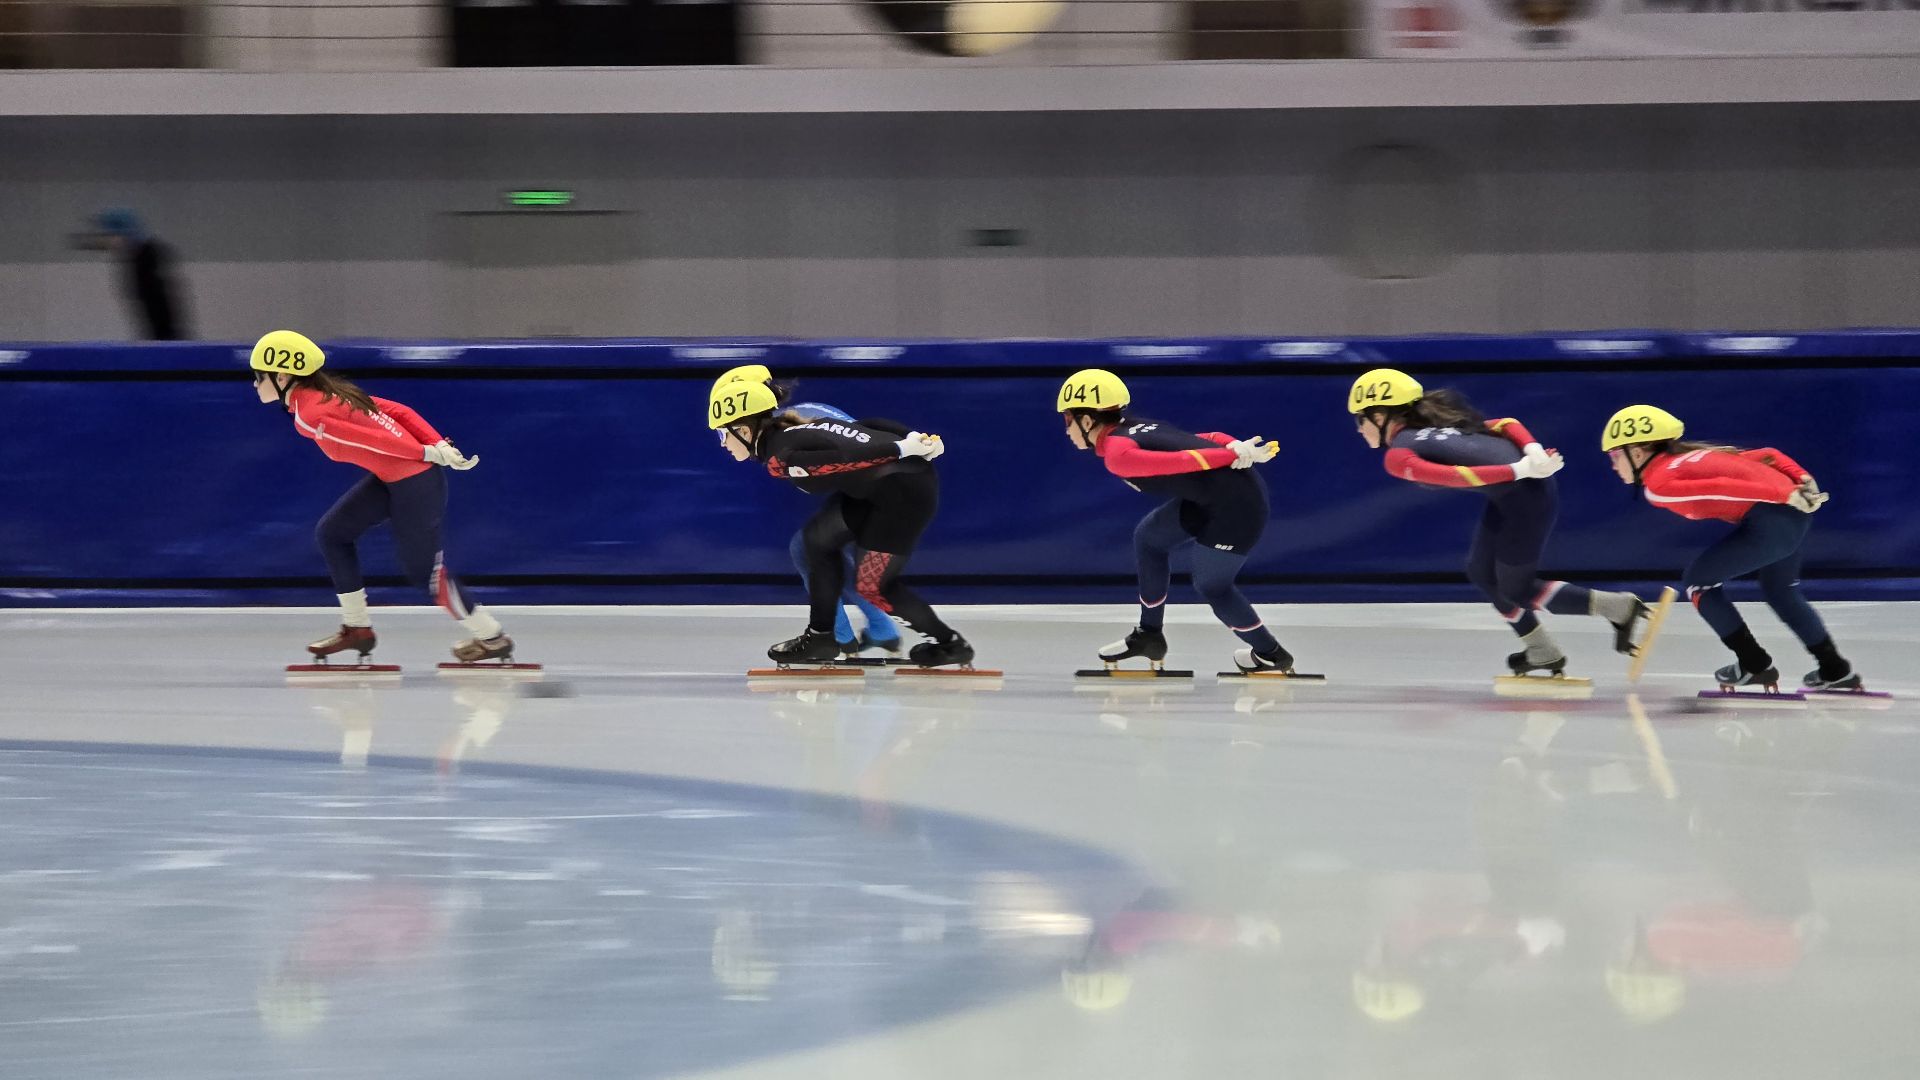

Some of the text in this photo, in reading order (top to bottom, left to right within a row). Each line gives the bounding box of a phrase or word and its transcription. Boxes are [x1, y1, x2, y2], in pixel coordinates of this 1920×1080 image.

[263, 346, 306, 371] 028
[1063, 383, 1101, 405] 041
[1354, 381, 1394, 404] 042
[712, 391, 749, 420] 037
[1610, 416, 1654, 440] 033
